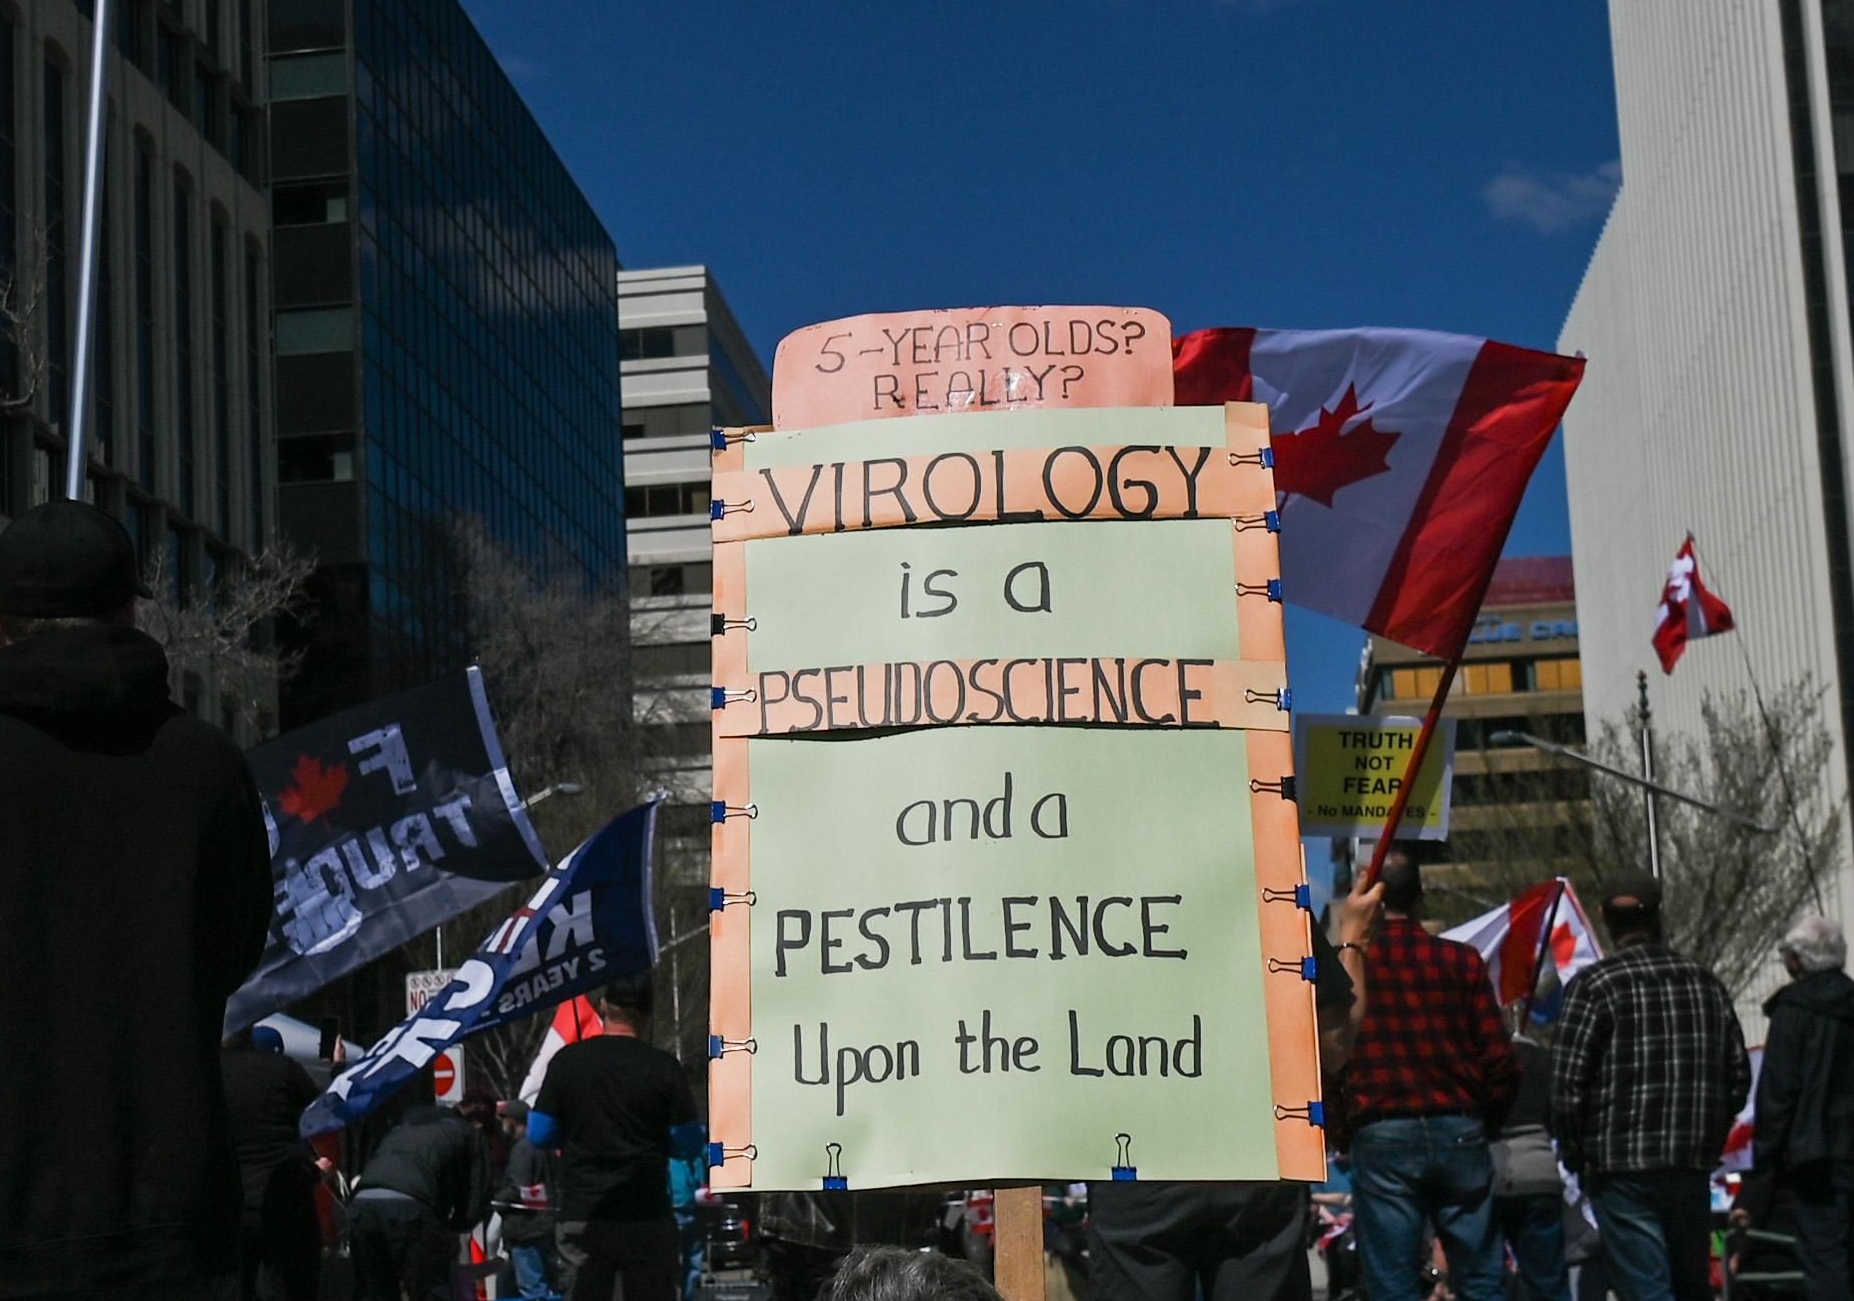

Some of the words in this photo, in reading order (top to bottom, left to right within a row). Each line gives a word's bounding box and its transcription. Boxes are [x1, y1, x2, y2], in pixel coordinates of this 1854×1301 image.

[1008, 318, 1147, 357] OLDS?
[873, 363, 1085, 412] REALLY?
[759, 444, 1213, 536] VIROLOGY
[900, 561, 959, 620] is
[1003, 560, 1053, 615] a
[757, 656, 1221, 735] PSEUDOSCIENCE
[1339, 732, 1413, 749] TRUTH
[1354, 755, 1394, 771] NOT
[896, 771, 1013, 847] and
[1030, 790, 1069, 840] a
[1318, 804, 1337, 817] No
[1342, 804, 1425, 818] MANDES
[1343, 778, 1403, 795] FEAR
[773, 894, 1188, 977] PESTILENCE
[410, 990, 427, 1012] NO
[794, 1021, 920, 1116] Upon
[955, 1010, 1041, 1075] the
[1067, 1009, 1203, 1079] Land
